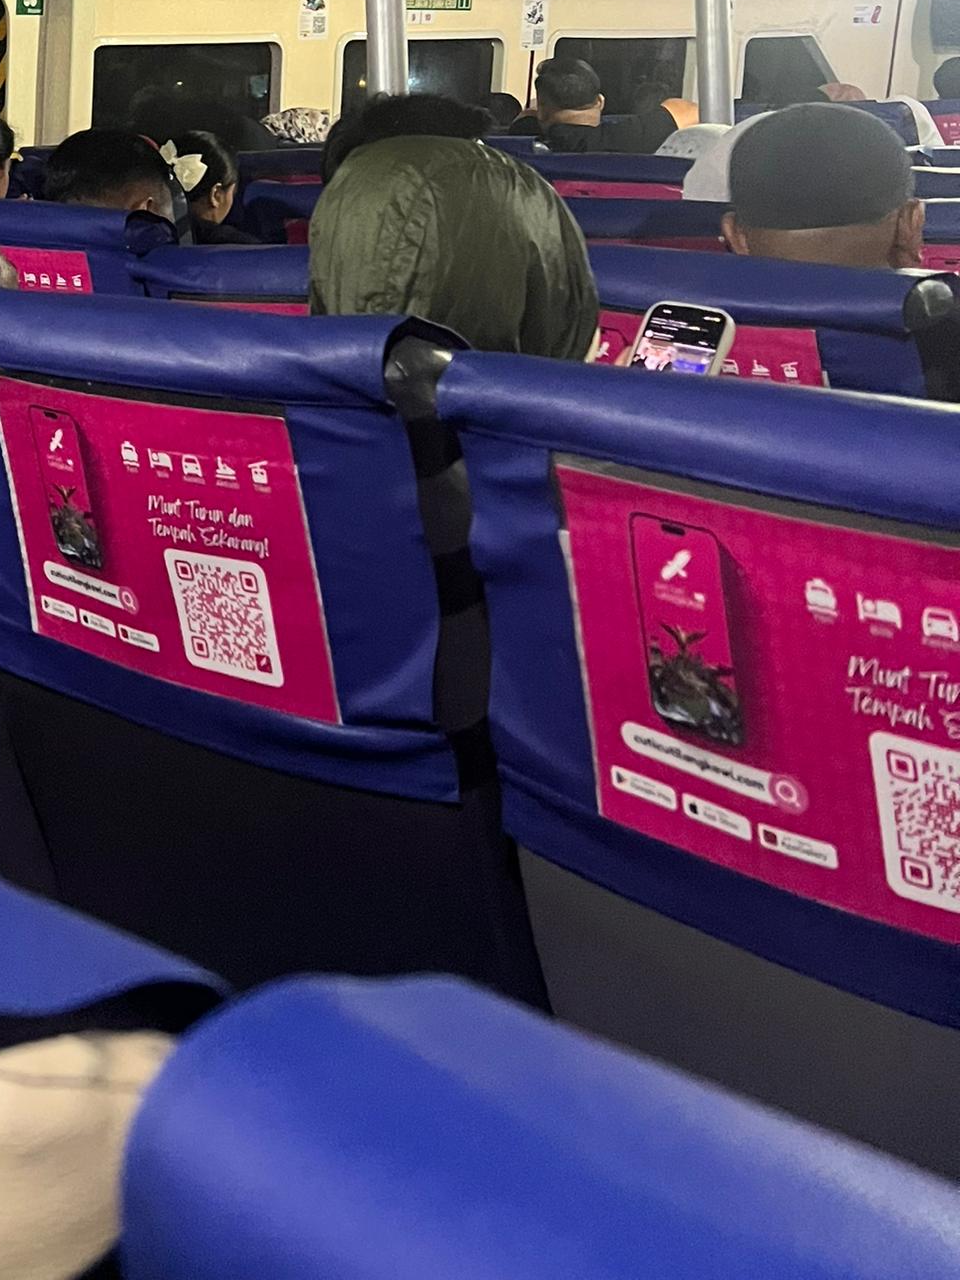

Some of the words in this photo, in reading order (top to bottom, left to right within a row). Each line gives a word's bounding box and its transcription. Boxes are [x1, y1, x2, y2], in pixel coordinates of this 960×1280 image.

[184, 500, 225, 524] Turun
[228, 507, 254, 528] dan
[147, 517, 196, 543] Tempah
[845, 686, 935, 731] Tempah
